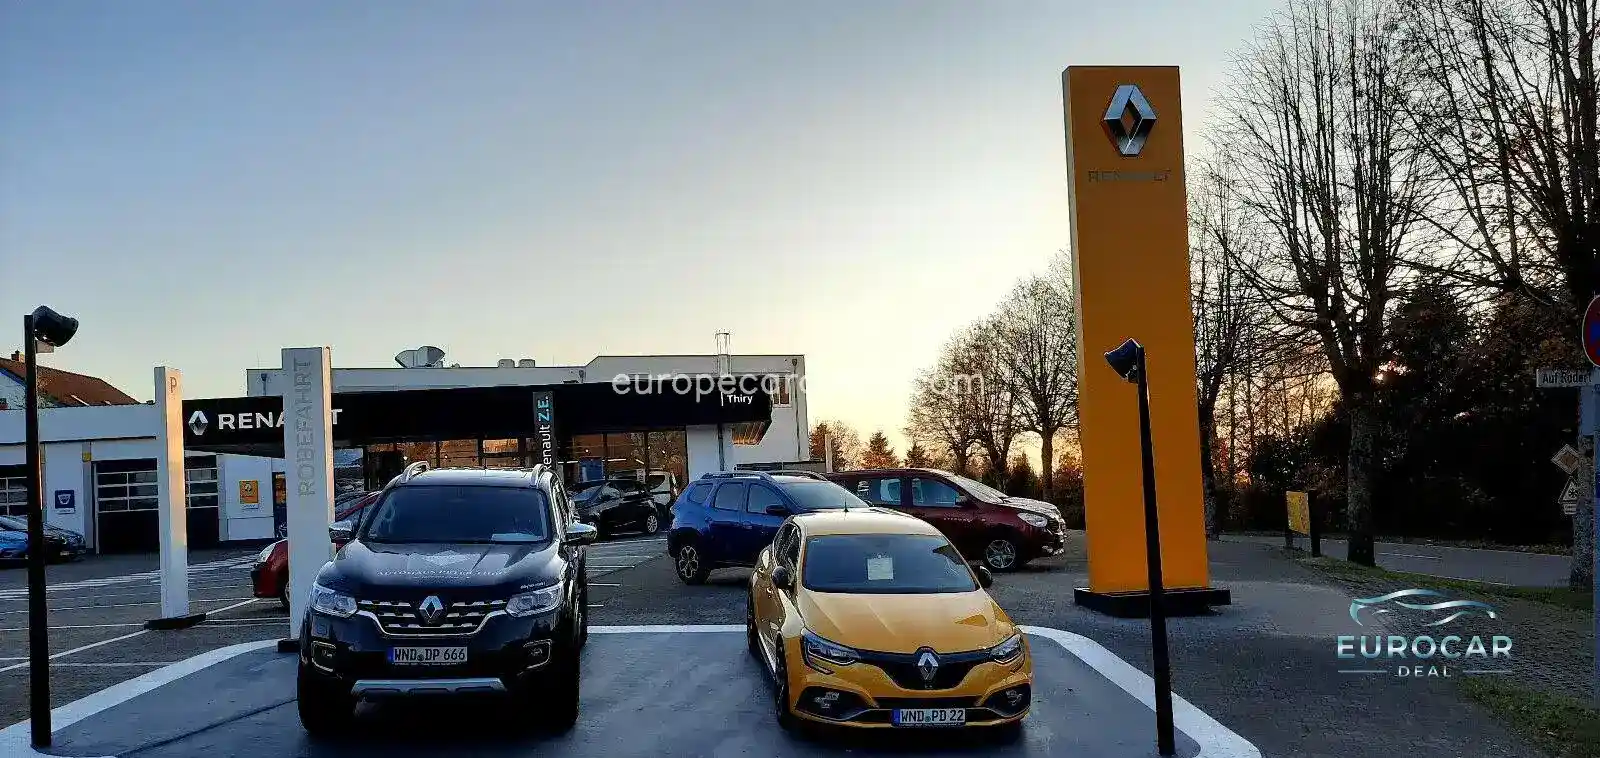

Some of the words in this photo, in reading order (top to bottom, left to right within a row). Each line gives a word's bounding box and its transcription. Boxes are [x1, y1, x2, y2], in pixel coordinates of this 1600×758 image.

[1087, 170, 1171, 182] RENLT
[169, 376, 178, 393] P
[1542, 372, 1558, 384] Auf
[726, 394, 753, 405] Thiry
[537, 395, 550, 422] Z.E.
[218, 408, 343, 430] RENT
[394, 648, 417, 661] WND
[425, 648, 440, 661] DP
[443, 648, 466, 661] 666
[901, 709, 925, 722] WND
[931, 709, 947, 722] PD
[949, 709, 965, 722] 22
